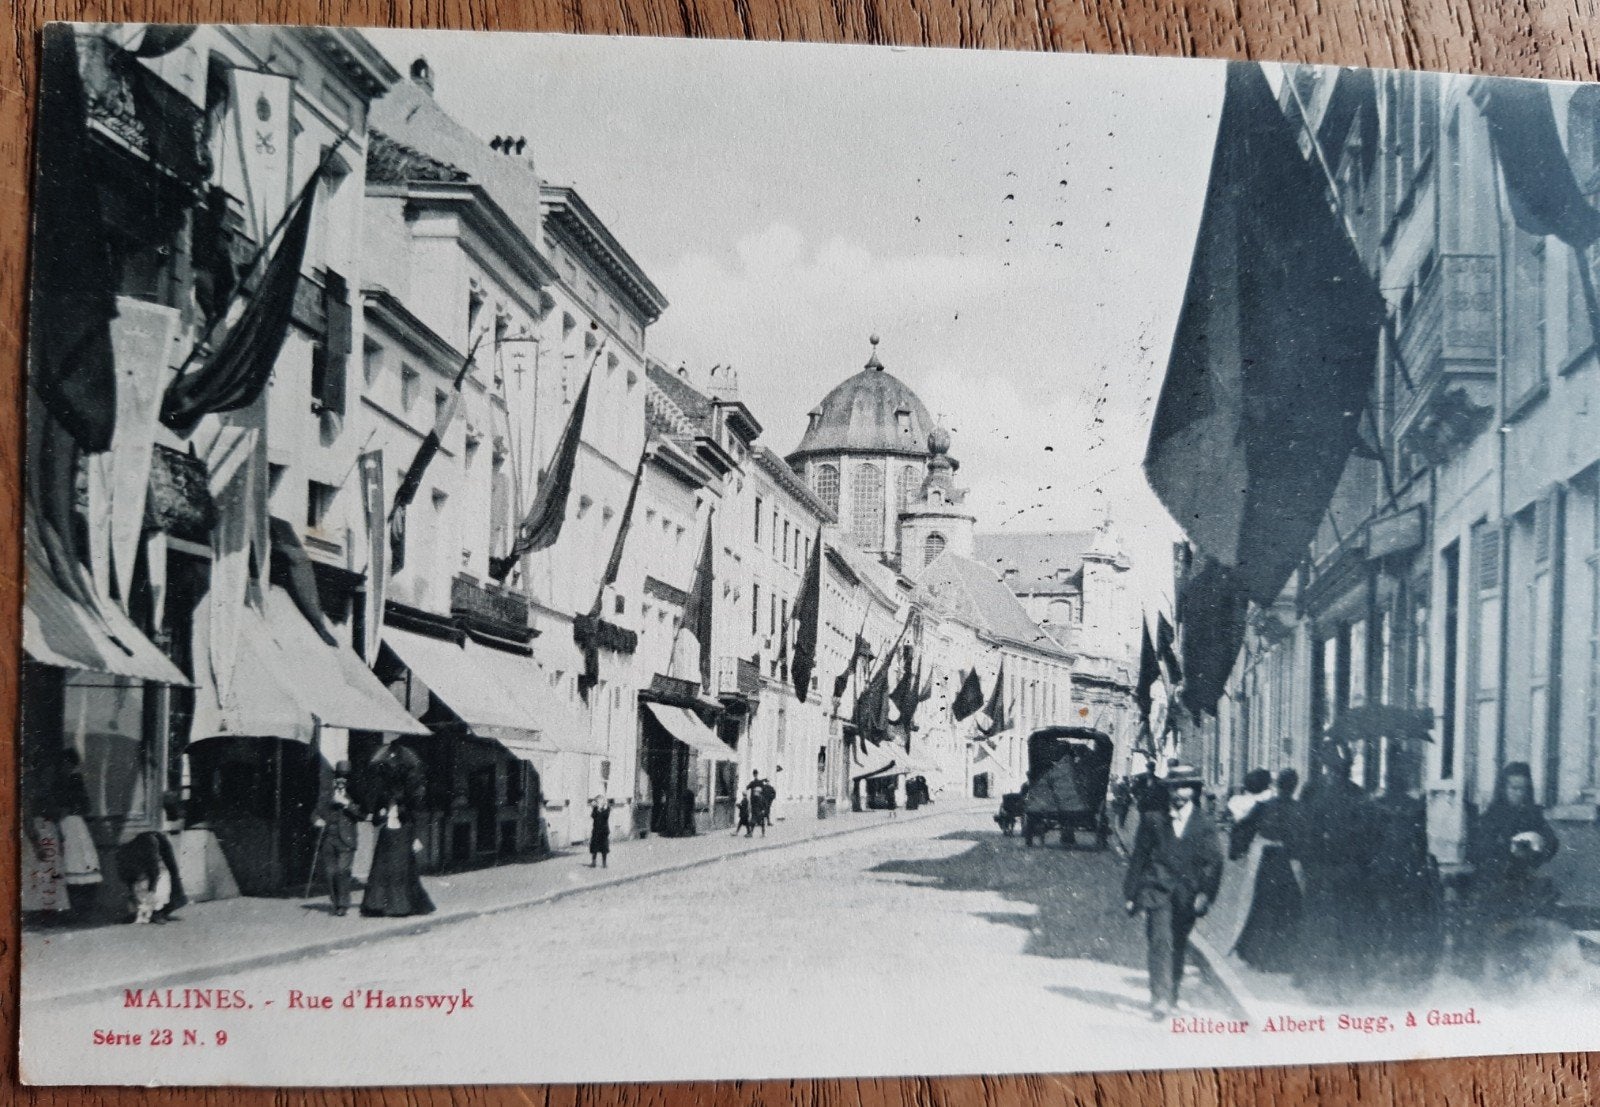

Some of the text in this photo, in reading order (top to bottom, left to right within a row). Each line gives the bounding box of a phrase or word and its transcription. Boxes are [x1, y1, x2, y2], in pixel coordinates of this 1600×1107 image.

[123, 989, 254, 1009] MALINES.
[288, 990, 333, 1009] Rue
[342, 988, 474, 1015] d'Hanswyk
[1171, 1017, 1249, 1034] Editeur
[1262, 1015, 1326, 1032] Albert
[1338, 1014, 1395, 1034] Sugg,
[1426, 1008, 1481, 1026] Gand.
[92, 1029, 142, 1046] Série
[150, 1029, 173, 1046] 23
[215, 1030, 228, 1046] 9
